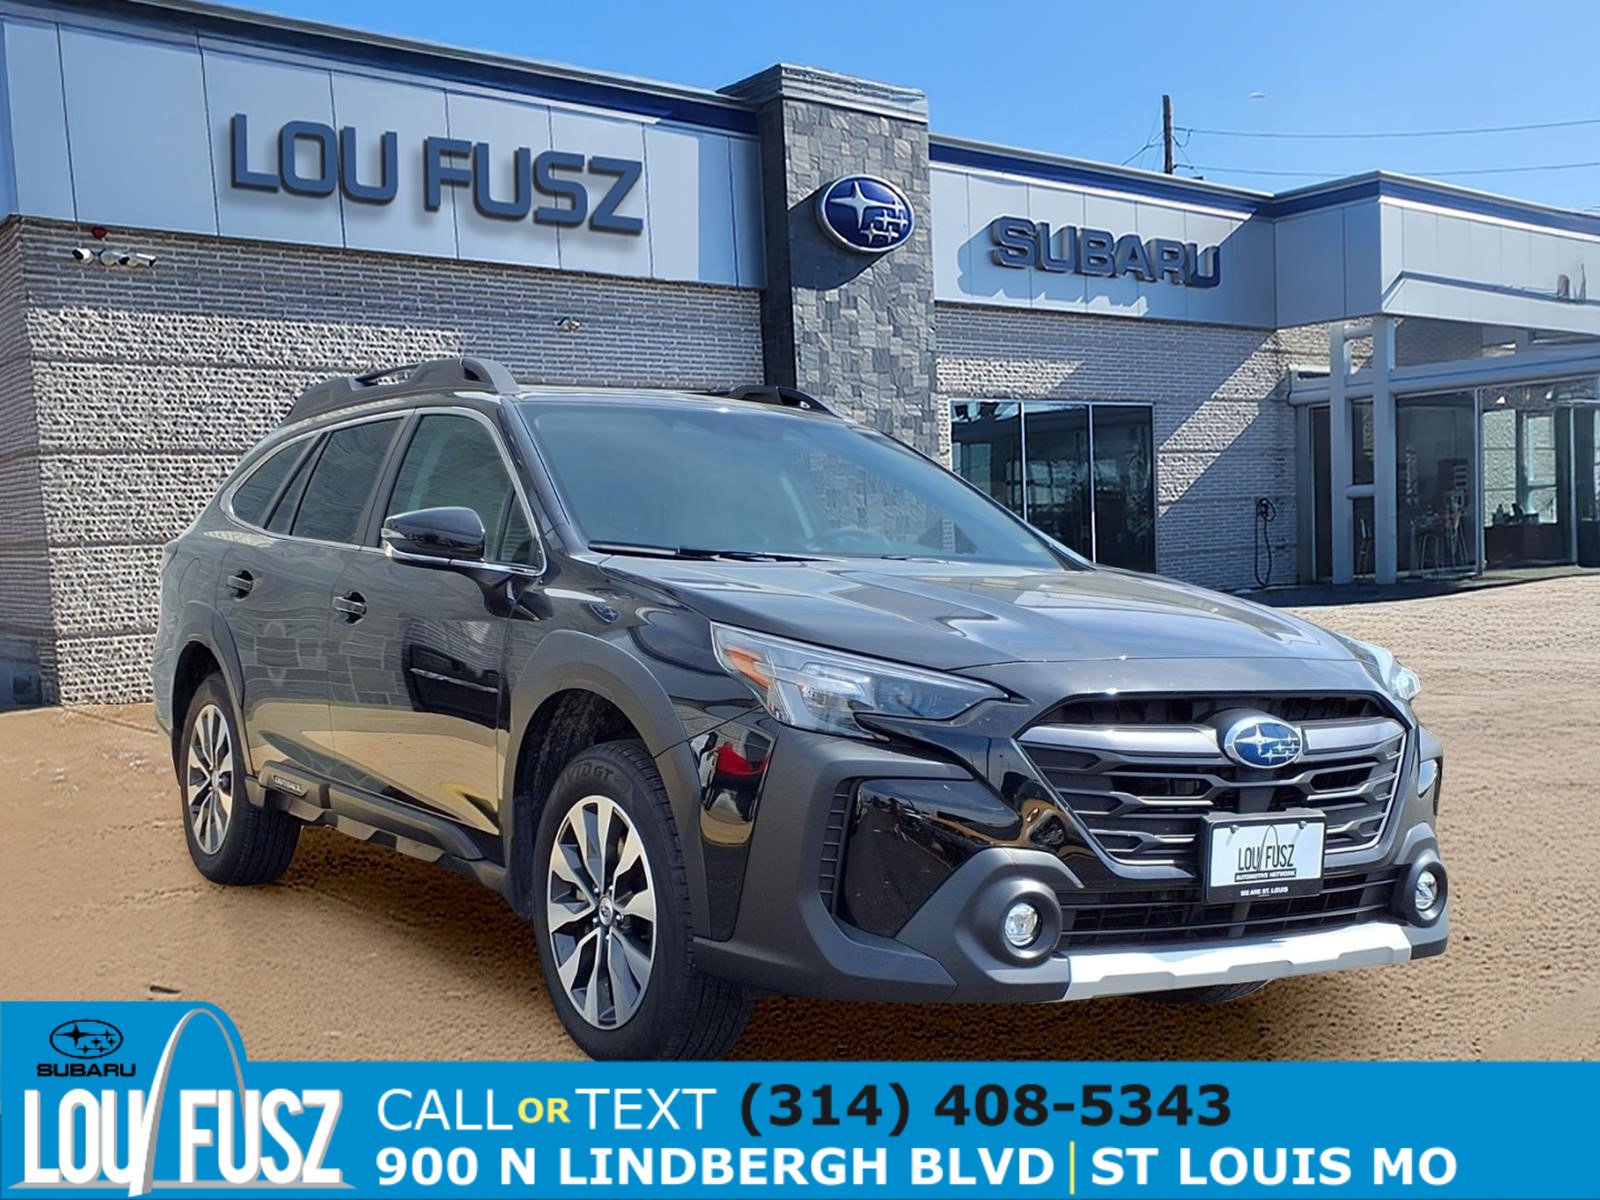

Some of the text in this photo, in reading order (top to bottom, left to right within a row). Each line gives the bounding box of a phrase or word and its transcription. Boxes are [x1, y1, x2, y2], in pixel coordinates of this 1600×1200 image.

[231, 113, 644, 236] LOU FUSZ
[992, 216, 1220, 288] SUBARU
[1238, 844, 1295, 871] LOU FUSZ
